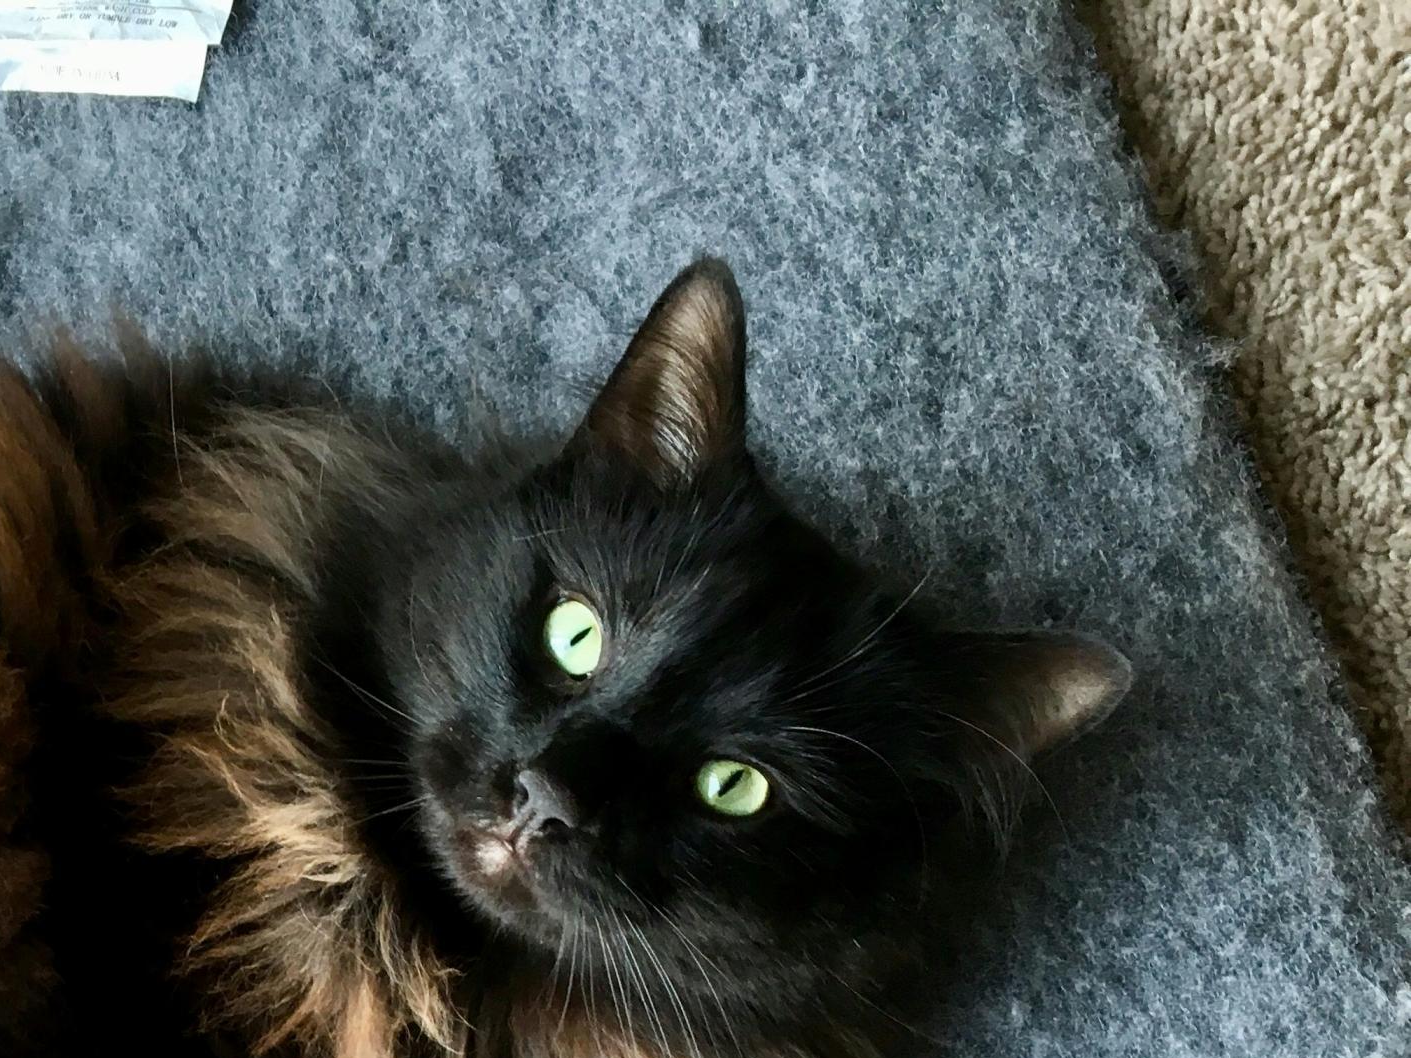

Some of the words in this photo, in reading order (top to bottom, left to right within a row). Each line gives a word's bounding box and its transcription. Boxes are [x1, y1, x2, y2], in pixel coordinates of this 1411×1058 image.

[132, 7, 157, 15] COLD
[56, 12, 73, 20] DRY
[97, 13, 131, 23] TUMBLE
[135, 17, 154, 26] DRY
[158, 18, 178, 28] LOW
